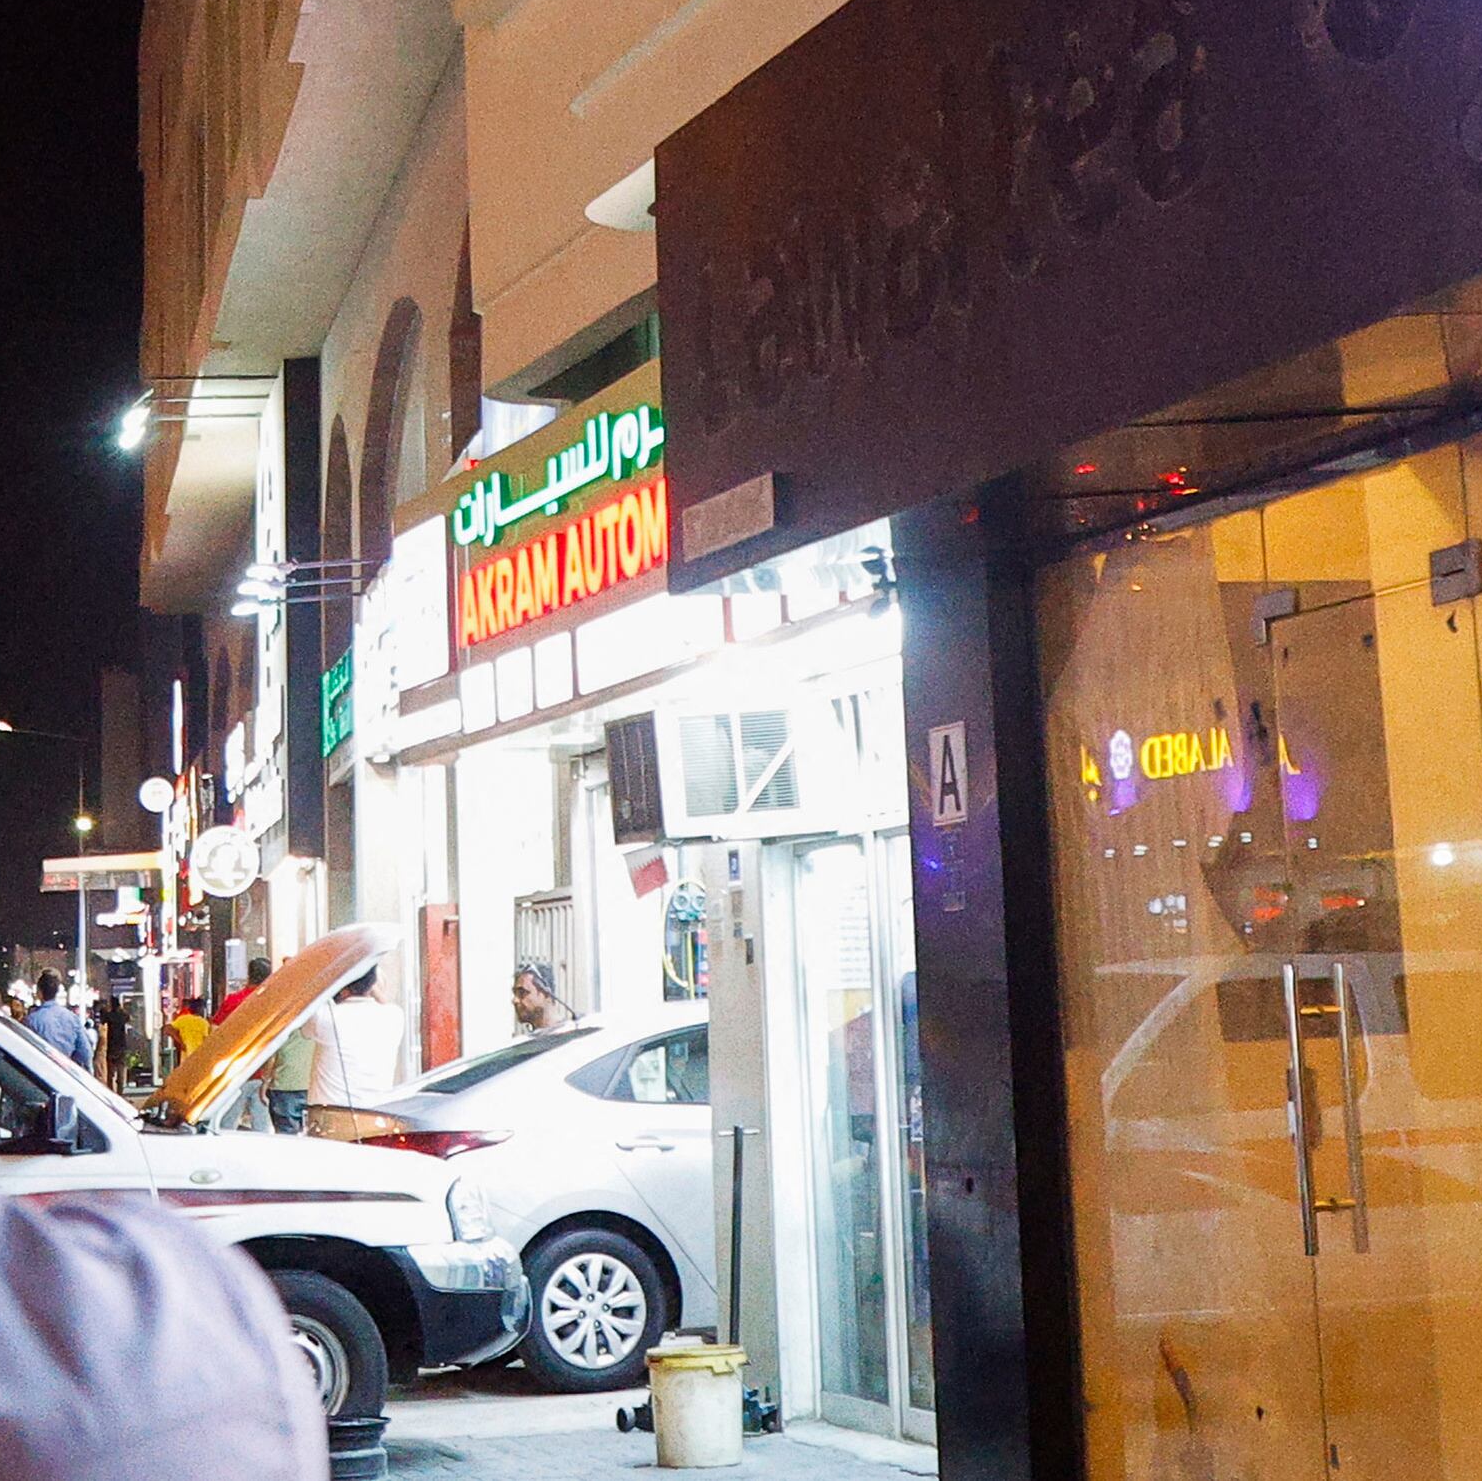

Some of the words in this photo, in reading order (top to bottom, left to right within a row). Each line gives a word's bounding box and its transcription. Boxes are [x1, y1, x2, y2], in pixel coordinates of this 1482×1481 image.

[459, 533, 559, 649] AKRAM
[563, 476, 668, 607] AUTOM
[939, 734, 962, 815] A
